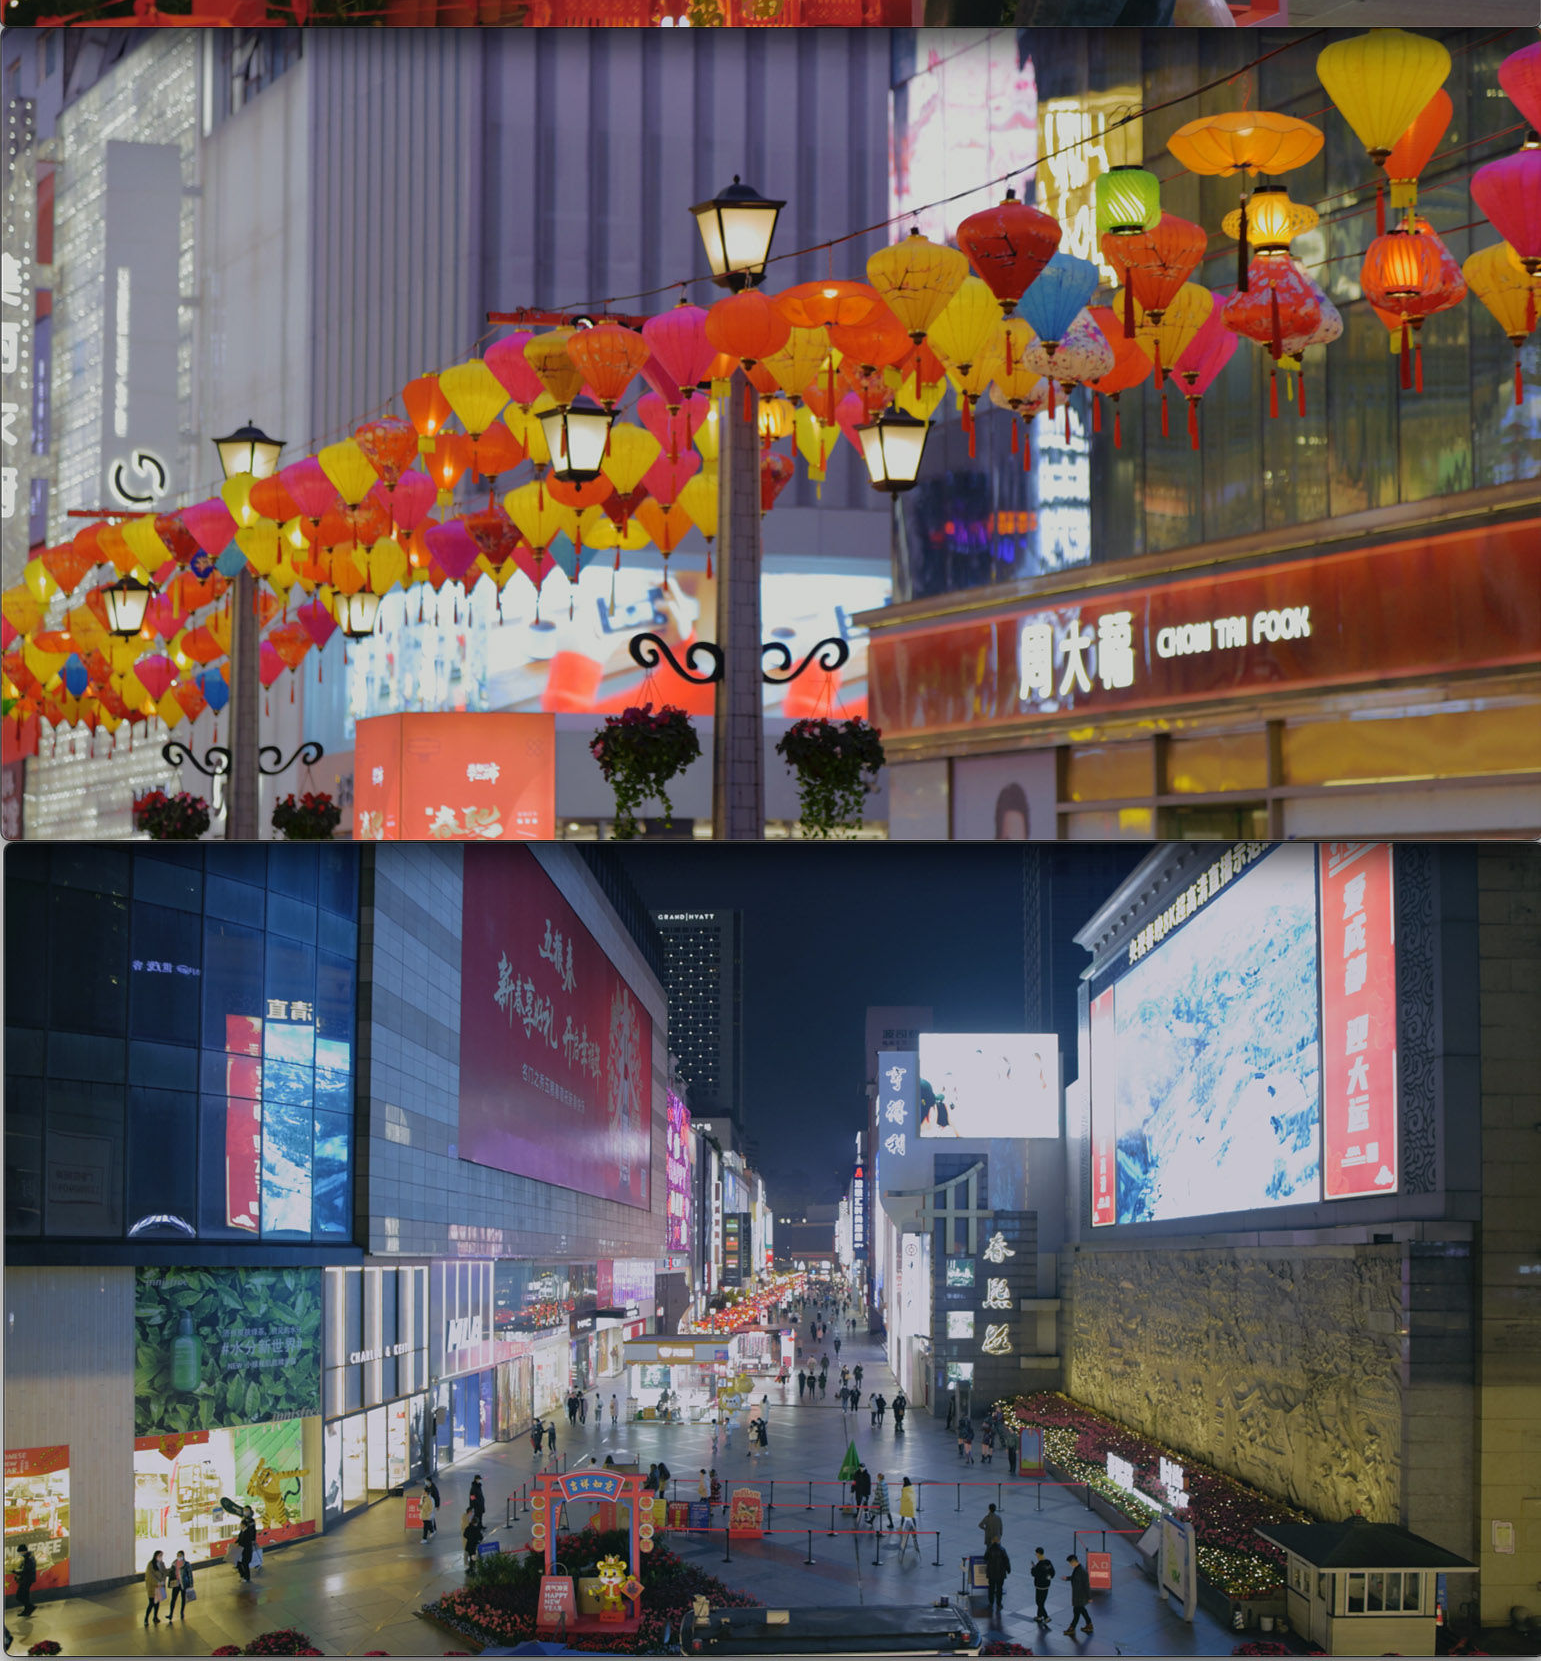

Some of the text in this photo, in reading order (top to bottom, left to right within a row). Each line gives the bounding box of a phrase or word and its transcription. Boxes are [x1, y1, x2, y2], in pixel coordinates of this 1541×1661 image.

[1019, 610, 1135, 700] 周大福
[1157, 606, 1311, 658] CHOW TAI FOOK
[981, 1231, 1016, 1355] 春熙路
[570, 1478, 614, 1493] 吉祥如意
